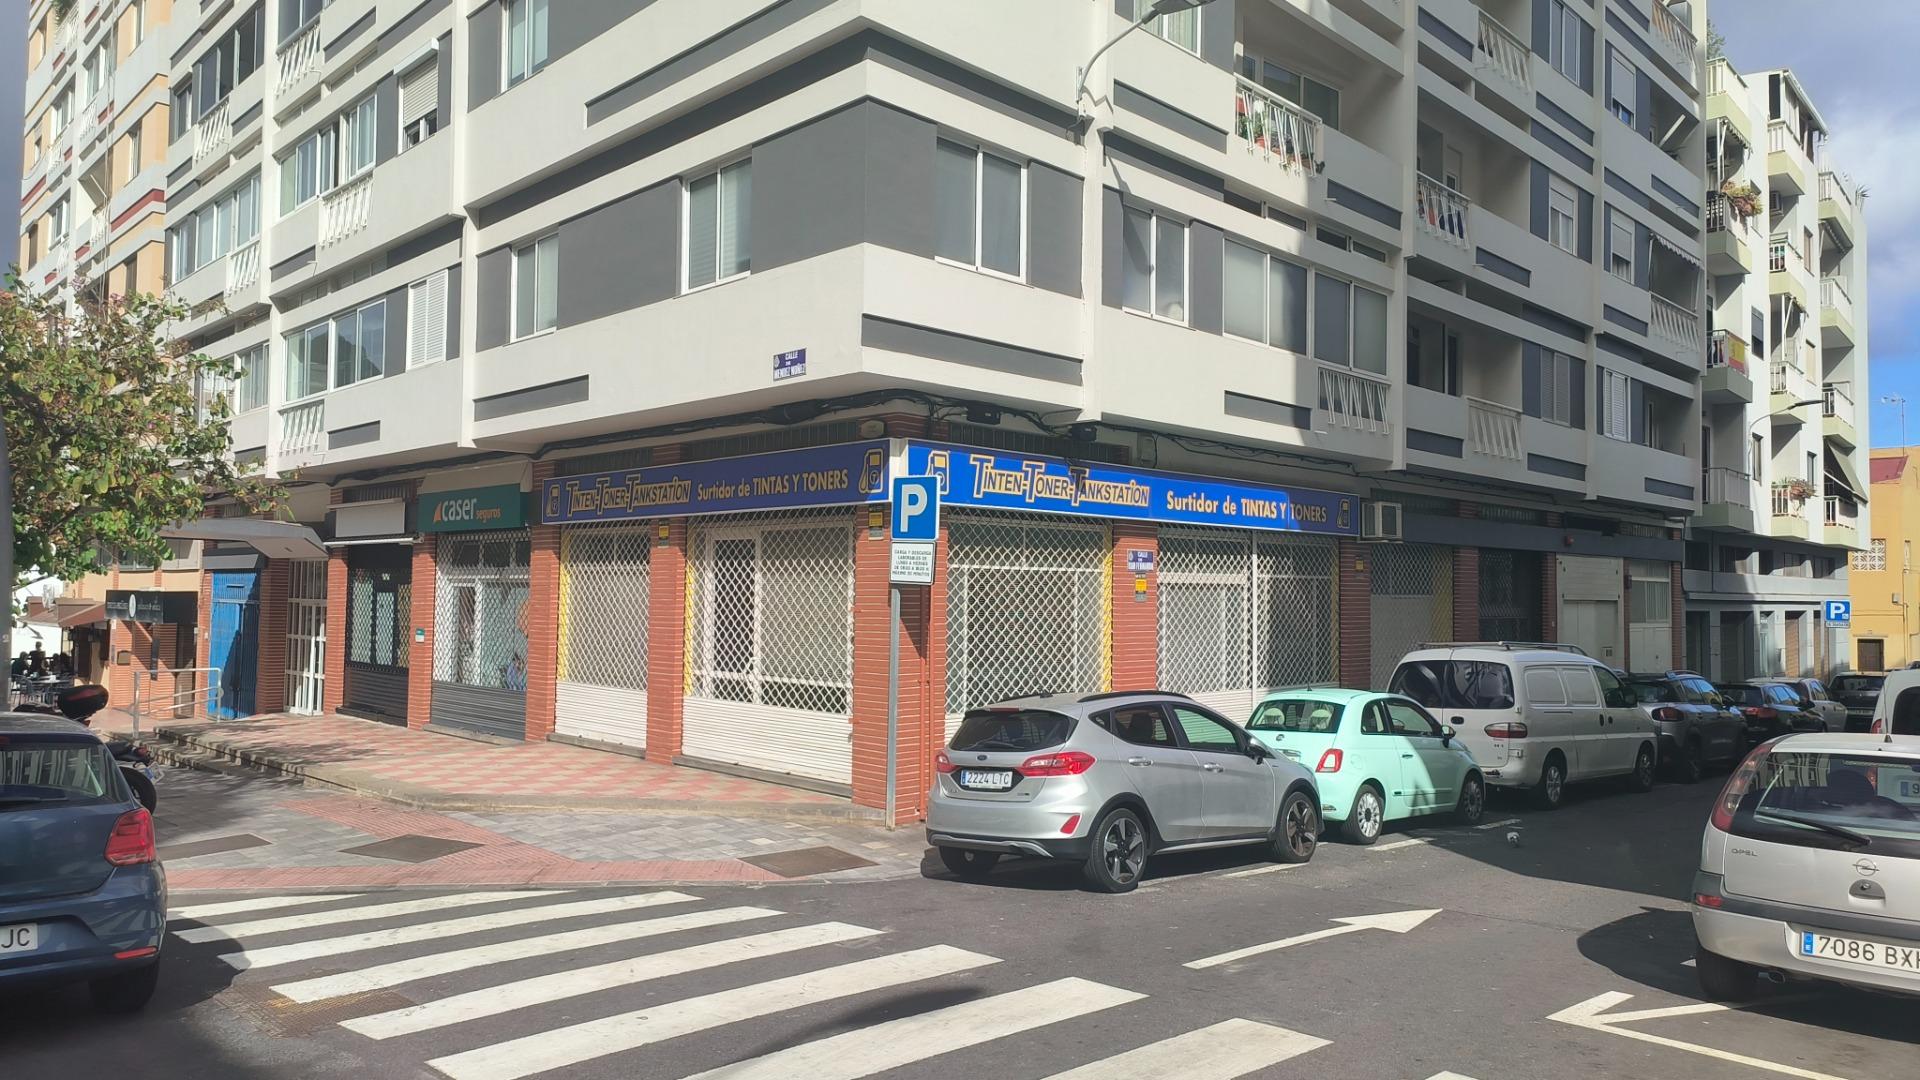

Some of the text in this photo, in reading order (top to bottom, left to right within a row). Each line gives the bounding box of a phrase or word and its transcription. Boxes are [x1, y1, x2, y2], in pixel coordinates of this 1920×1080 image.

[785, 351, 798, 360] CALLE
[697, 479, 736, 501] Surtidor
[737, 478, 750, 497] de
[752, 474, 790, 496] TINTAS
[791, 474, 800, 492] Y
[802, 469, 848, 492] TONERS
[441, 498, 502, 523] caser seguros
[900, 484, 928, 533] P
[1166, 490, 1219, 513] Surtidor
[1222, 495, 1237, 516] de
[1240, 498, 1277, 519] TINTAS
[1278, 502, 1288, 519] Y
[1290, 503, 1327, 522] TONERS
[1830, 602, 1846, 619] P
[967, 772, 1010, 785] 2224 LTC
[1731, 848, 1758, 857] OPEL
[1, 927, 30, 948] JC
[1819, 936, 1875, 961] 7086
